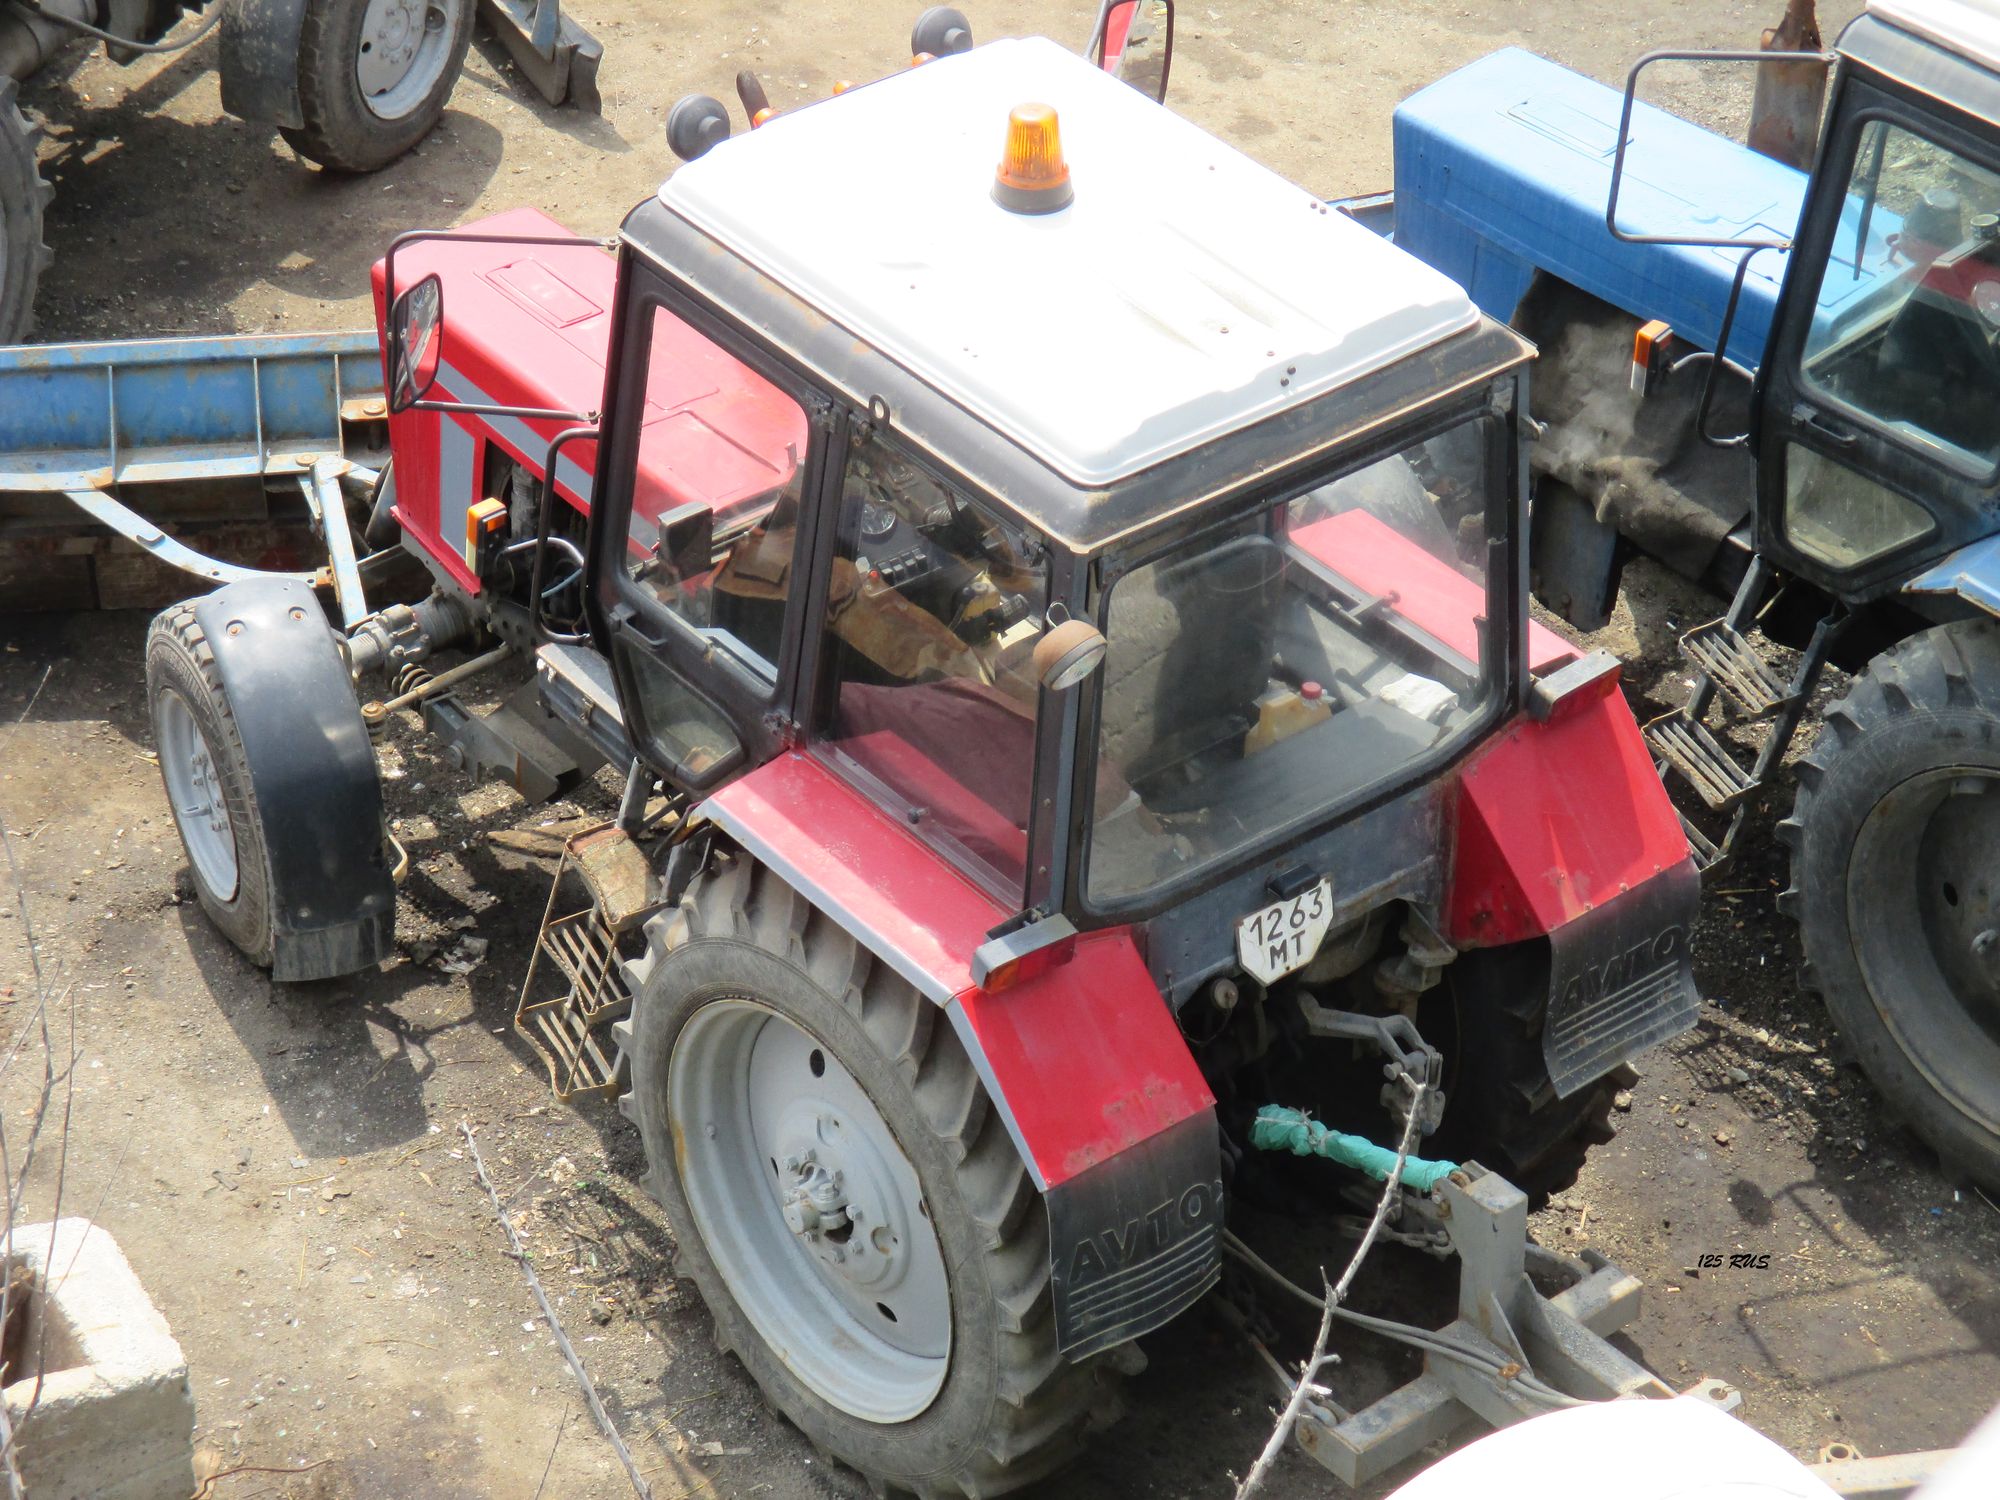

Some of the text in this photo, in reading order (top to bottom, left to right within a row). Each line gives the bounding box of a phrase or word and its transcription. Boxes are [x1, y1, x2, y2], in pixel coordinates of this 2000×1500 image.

[1249, 886, 1323, 946] 1263
[1269, 929, 1306, 970] MT
[1558, 925, 1684, 1014] AVTO
[1067, 1183, 1212, 1286] AVTO
